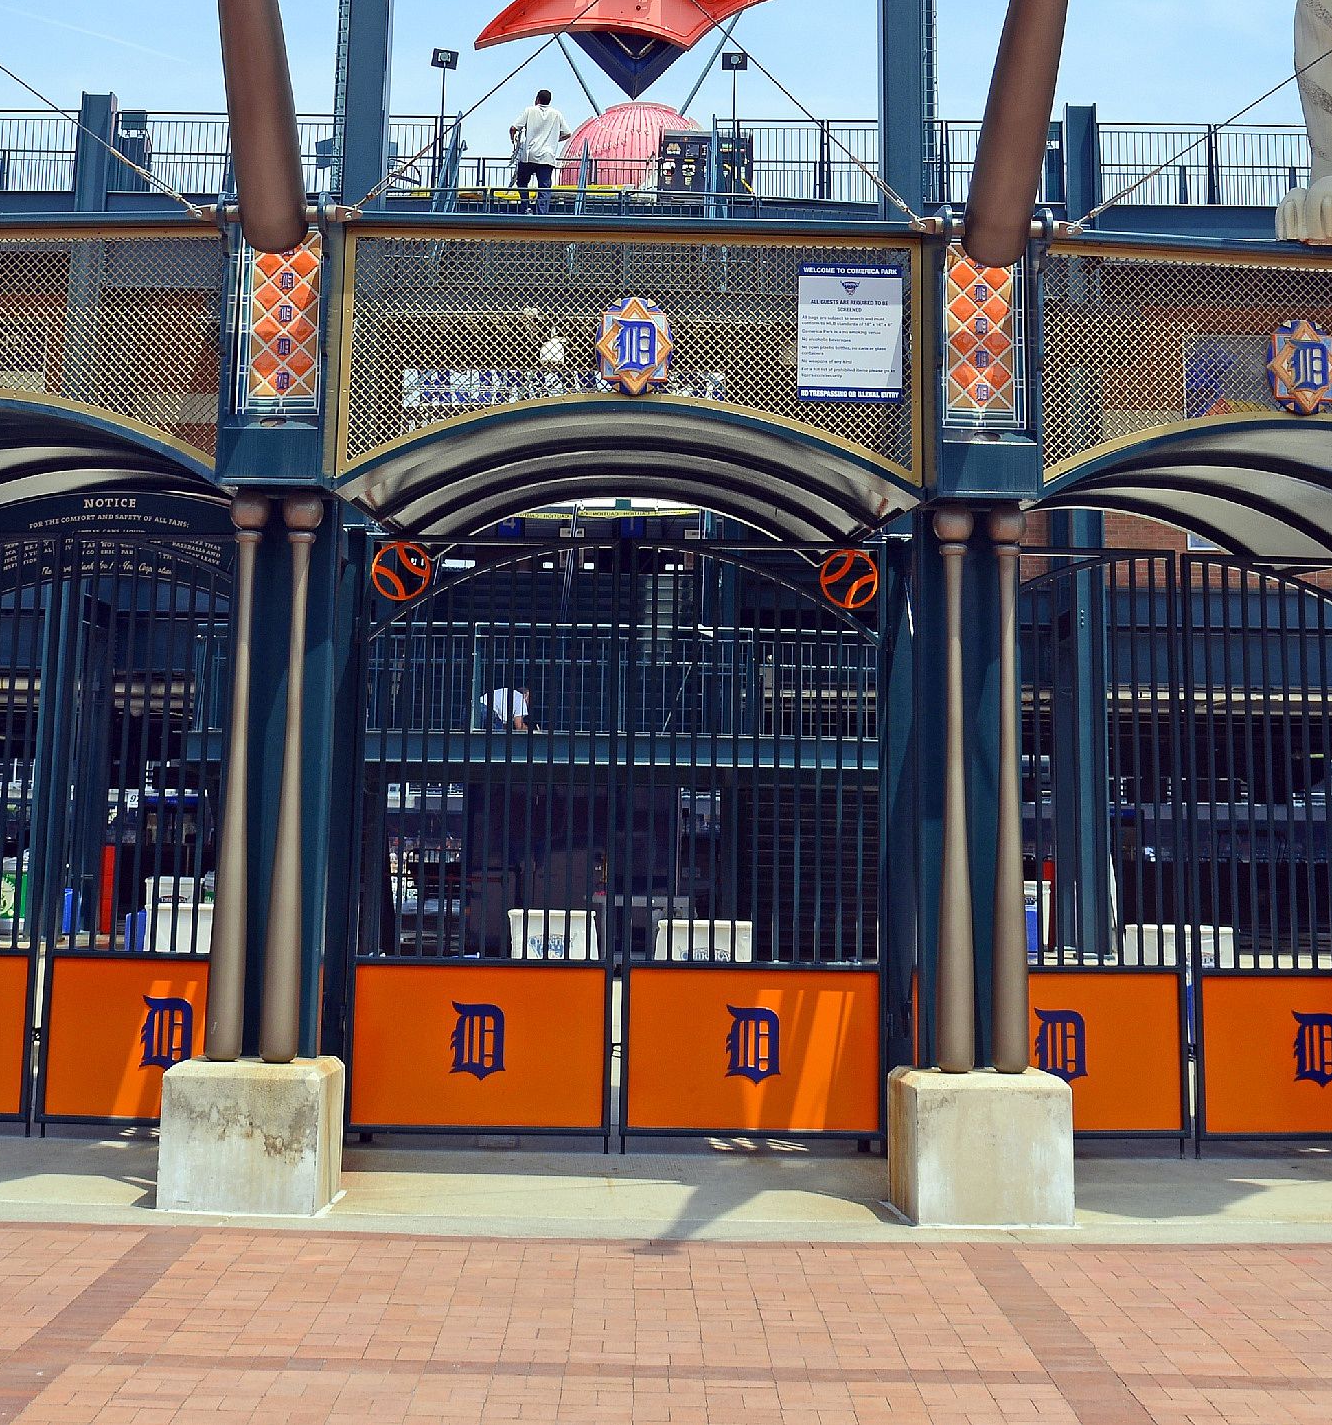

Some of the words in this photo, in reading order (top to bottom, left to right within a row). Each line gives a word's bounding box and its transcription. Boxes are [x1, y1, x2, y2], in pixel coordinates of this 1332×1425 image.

[847, 267, 880, 275] COMERICA
[83, 498, 137, 509] NOTICE
[29, 519, 44, 529] FOR
[44, 518, 60, 526] THE
[60, 514, 96, 524] COMFORT
[114, 513, 143, 522] SAFETY
[154, 516, 167, 524] ALL
